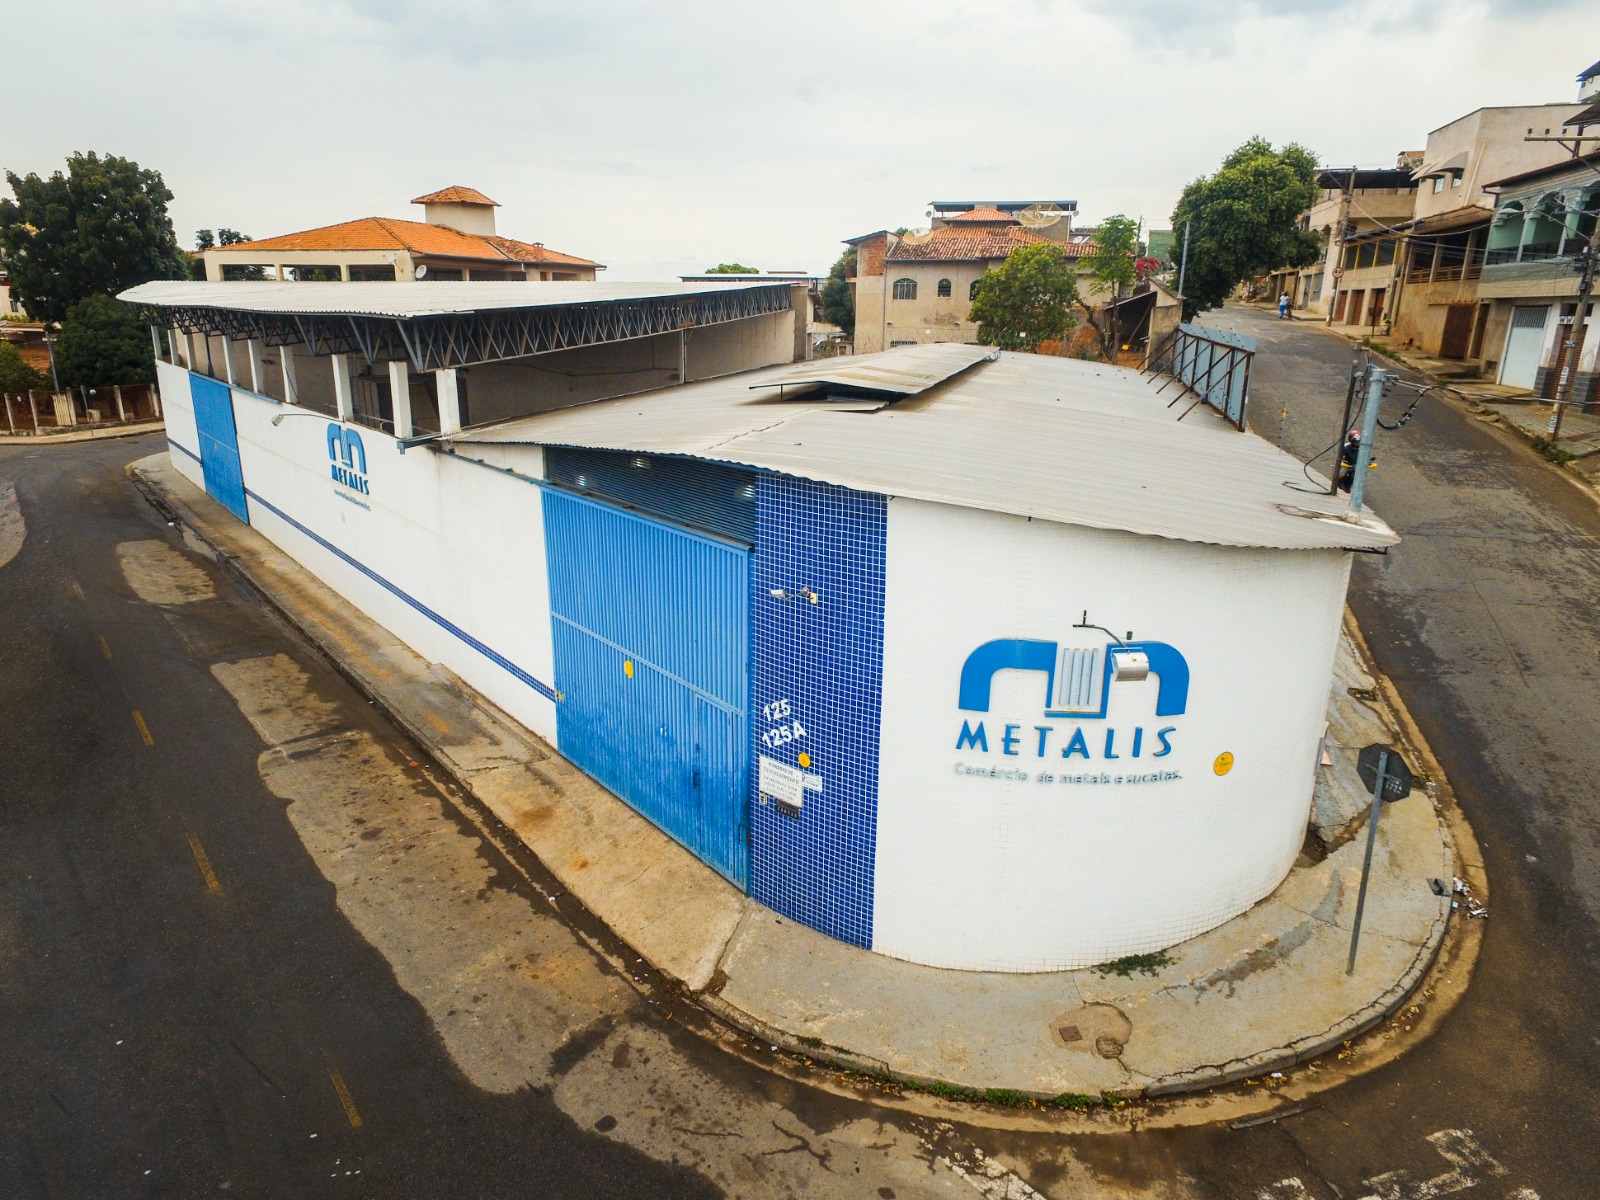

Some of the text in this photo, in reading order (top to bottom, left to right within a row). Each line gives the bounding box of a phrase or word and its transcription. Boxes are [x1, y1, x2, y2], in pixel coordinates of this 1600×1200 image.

[331, 464, 369, 495] METALIS
[763, 699, 791, 721] 125
[762, 720, 807, 748] 125A
[955, 719, 1176, 759] METALIS
[953, 761, 1028, 781] Comércio
[1036, 770, 1055, 784] de
[1059, 772, 1110, 785] metais
[1113, 776, 1123, 785] e
